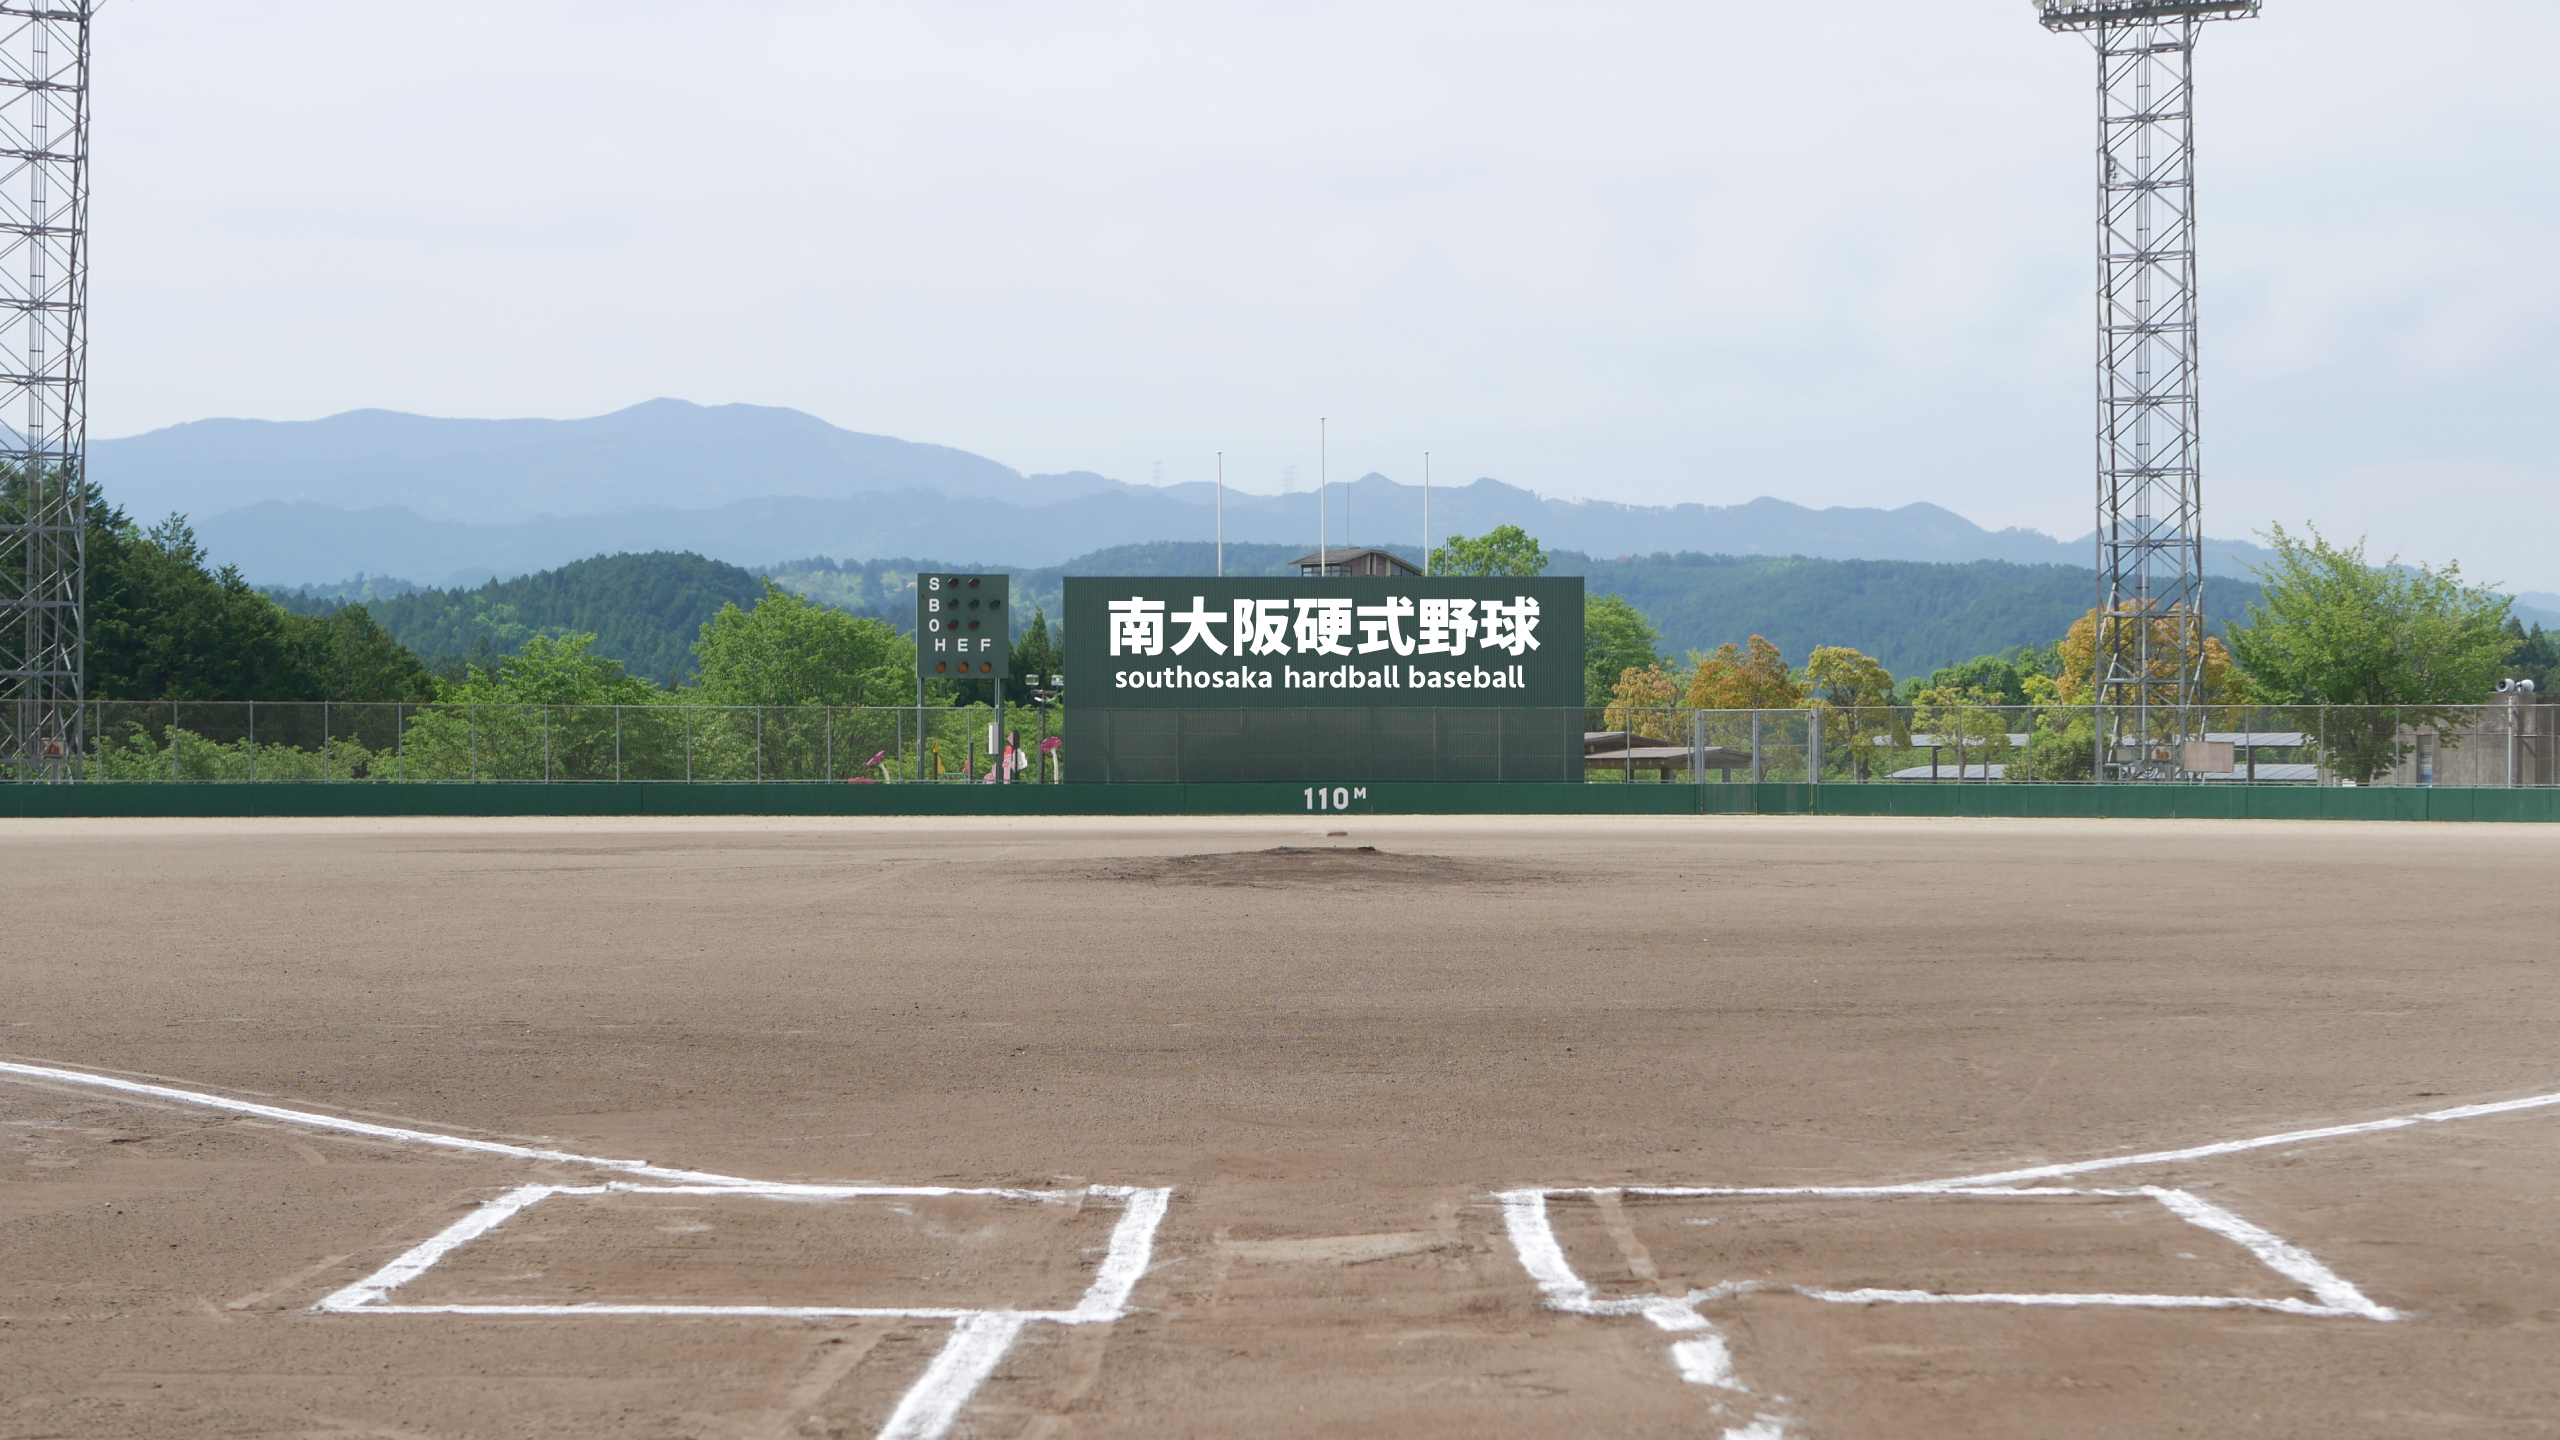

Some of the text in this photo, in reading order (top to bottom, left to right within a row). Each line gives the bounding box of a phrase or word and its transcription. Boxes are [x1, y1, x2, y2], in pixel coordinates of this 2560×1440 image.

[928, 577, 940, 591] S
[928, 598, 940, 612] B
[1108, 595, 1541, 657] 南大阪硬式野球
[934, 638, 992, 652] H E F
[1115, 664, 1526, 689] southosaka hardball baseball
